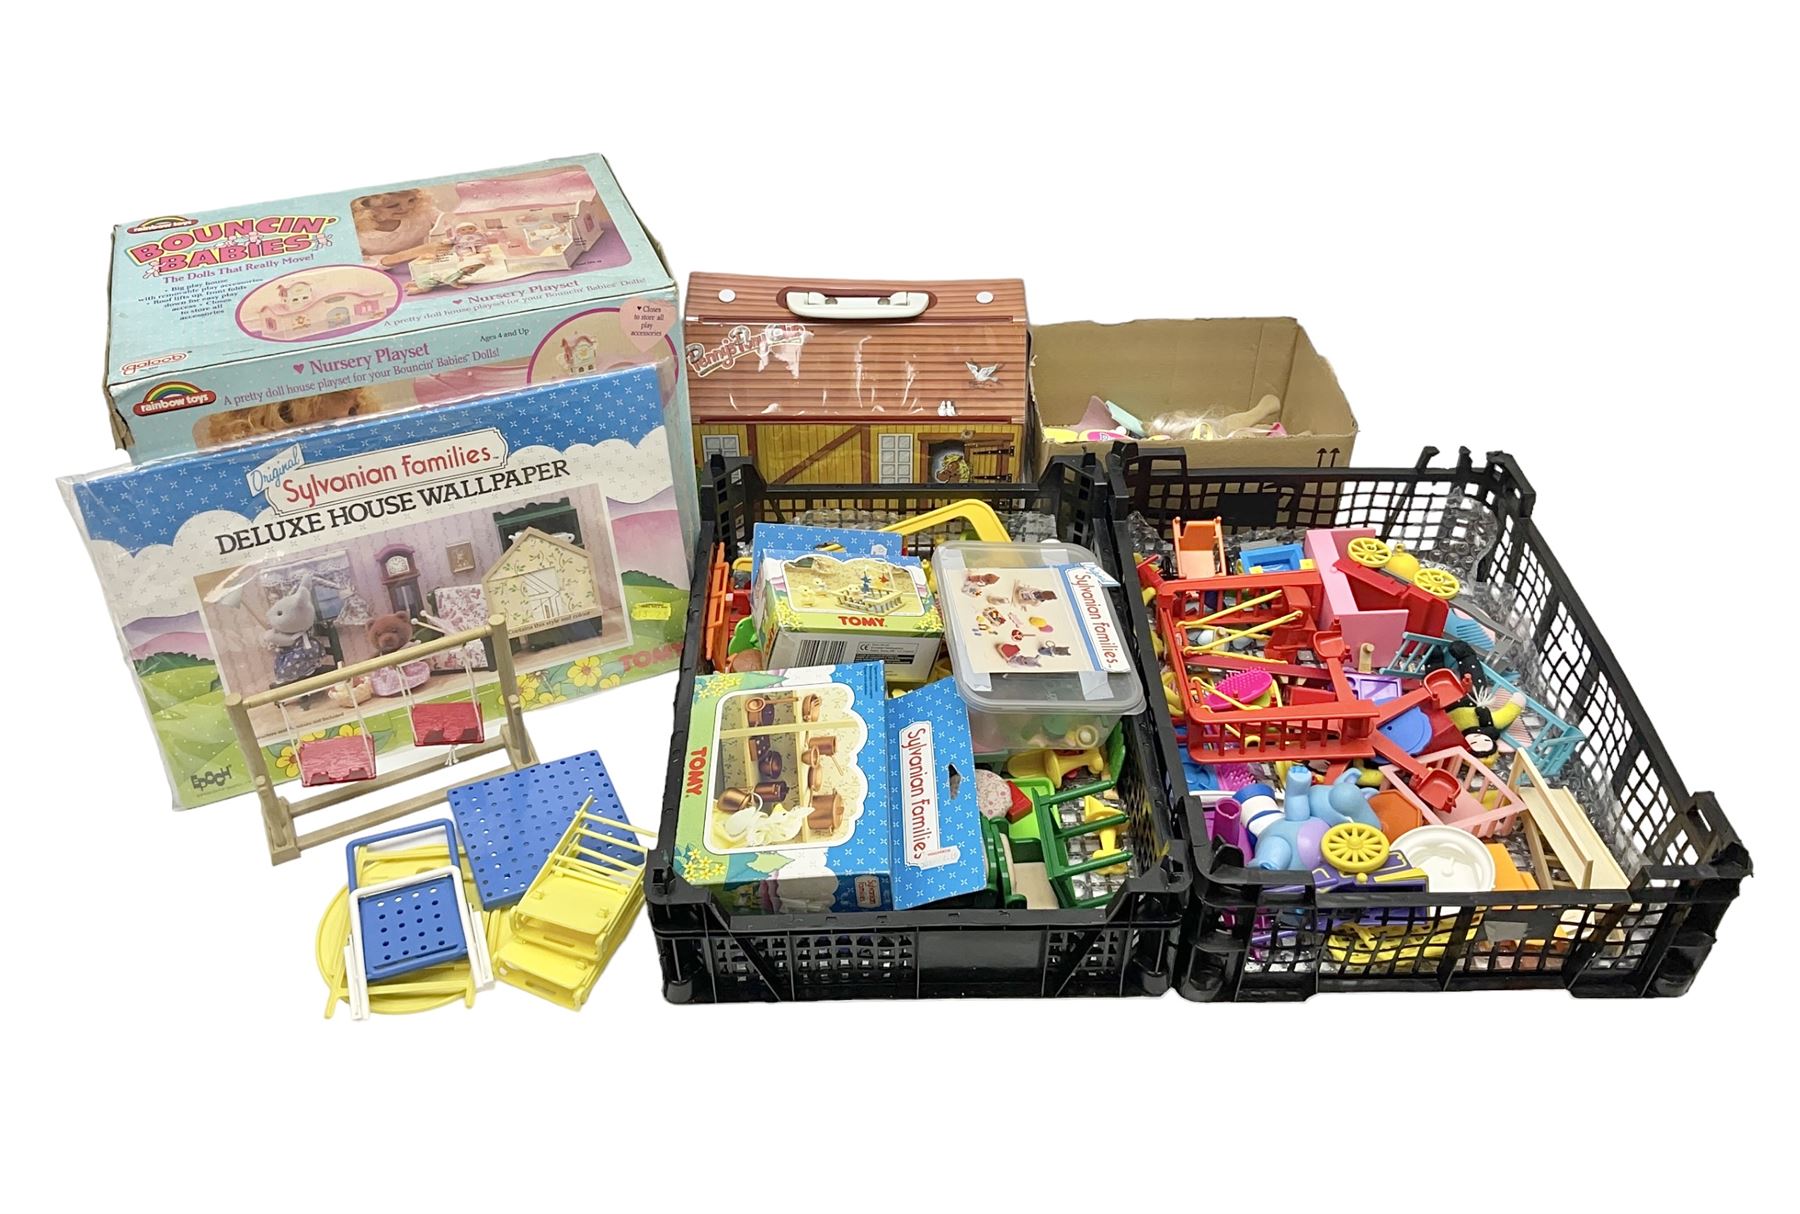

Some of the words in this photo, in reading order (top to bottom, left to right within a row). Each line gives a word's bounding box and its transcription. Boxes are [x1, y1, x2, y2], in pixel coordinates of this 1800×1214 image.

[130, 217, 337, 263] BOUNCIN'
[158, 234, 312, 272] BABIES
[163, 276, 185, 284] The
[187, 271, 216, 281] Dolls
[219, 266, 242, 275] That
[245, 259, 280, 271] Really
[282, 254, 314, 265] Move!
[393, 314, 422, 327] pretty
[424, 311, 442, 319] doll
[444, 307, 471, 317] house
[473, 301, 505, 312] playset
[507, 297, 520, 305] for
[522, 295, 543, 304] your
[620, 277, 646, 287] Dolls!
[467, 289, 526, 304] Nursery
[529, 280, 580, 294] Playset
[480, 333, 497, 343] Ages
[504, 330, 516, 338] and
[518, 327, 530, 337] Up
[641, 322, 653, 330] play
[122, 352, 186, 375] galoob
[309, 354, 372, 374] Nursery
[375, 342, 430, 364] Playset
[223, 395, 233, 405] A
[234, 389, 265, 407] pretty
[267, 385, 285, 397] doll
[286, 383, 316, 395] house
[318, 376, 352, 392] playset
[353, 371, 366, 383] for
[368, 371, 391, 382] your
[394, 360, 434, 375] Bouncin'
[472, 348, 500, 361] Dolls!
[141, 395, 185, 412] rainbow
[186, 392, 209, 405] toys
[251, 448, 301, 489] Original
[282, 471, 399, 508] Sylvanian
[401, 445, 491, 477] Families
[215, 513, 325, 554] DELUXE
[329, 492, 417, 528] HOUSE
[417, 459, 571, 506] WALLPAPER
[1071, 574, 1103, 620] Sylvanian
[534, 620, 545, 629] this
[546, 618, 560, 627] style
[838, 616, 886, 628] TOMY
[686, 746, 707, 795] TOMY
[901, 728, 928, 797] Sylvanian
